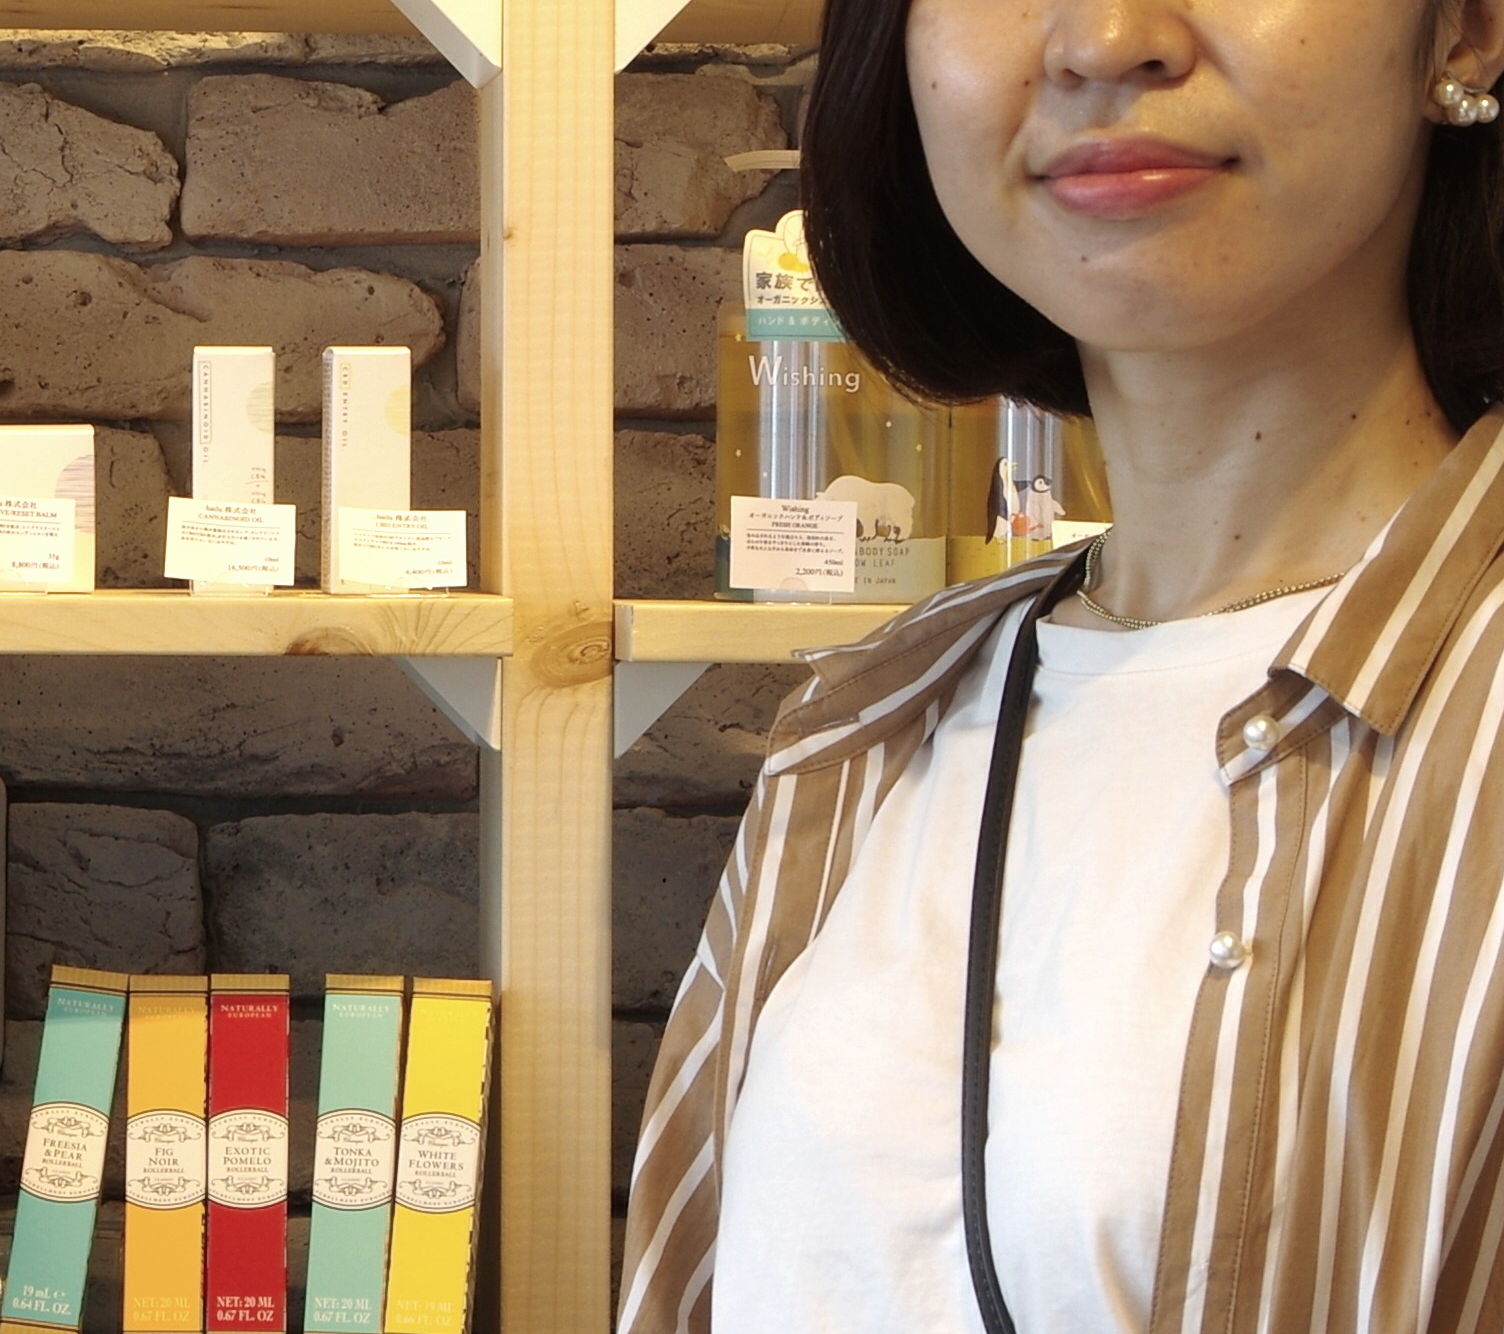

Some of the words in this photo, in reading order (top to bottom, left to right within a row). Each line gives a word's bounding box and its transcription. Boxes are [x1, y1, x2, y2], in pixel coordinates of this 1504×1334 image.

[748, 355, 860, 392] Wishing
[781, 505, 809, 513] Wishing
[43, 1138, 87, 1151] FREESIA
[155, 1148, 173, 1156] FIG
[225, 1147, 270, 1155] EXOTIC
[334, 1147, 371, 1157] TONKA
[418, 1150, 456, 1160] WHITE
[149, 1157, 178, 1165] NOIR
[223, 1157, 271, 1165] POMELO
[408, 1160, 464, 1171] FLOWERS
